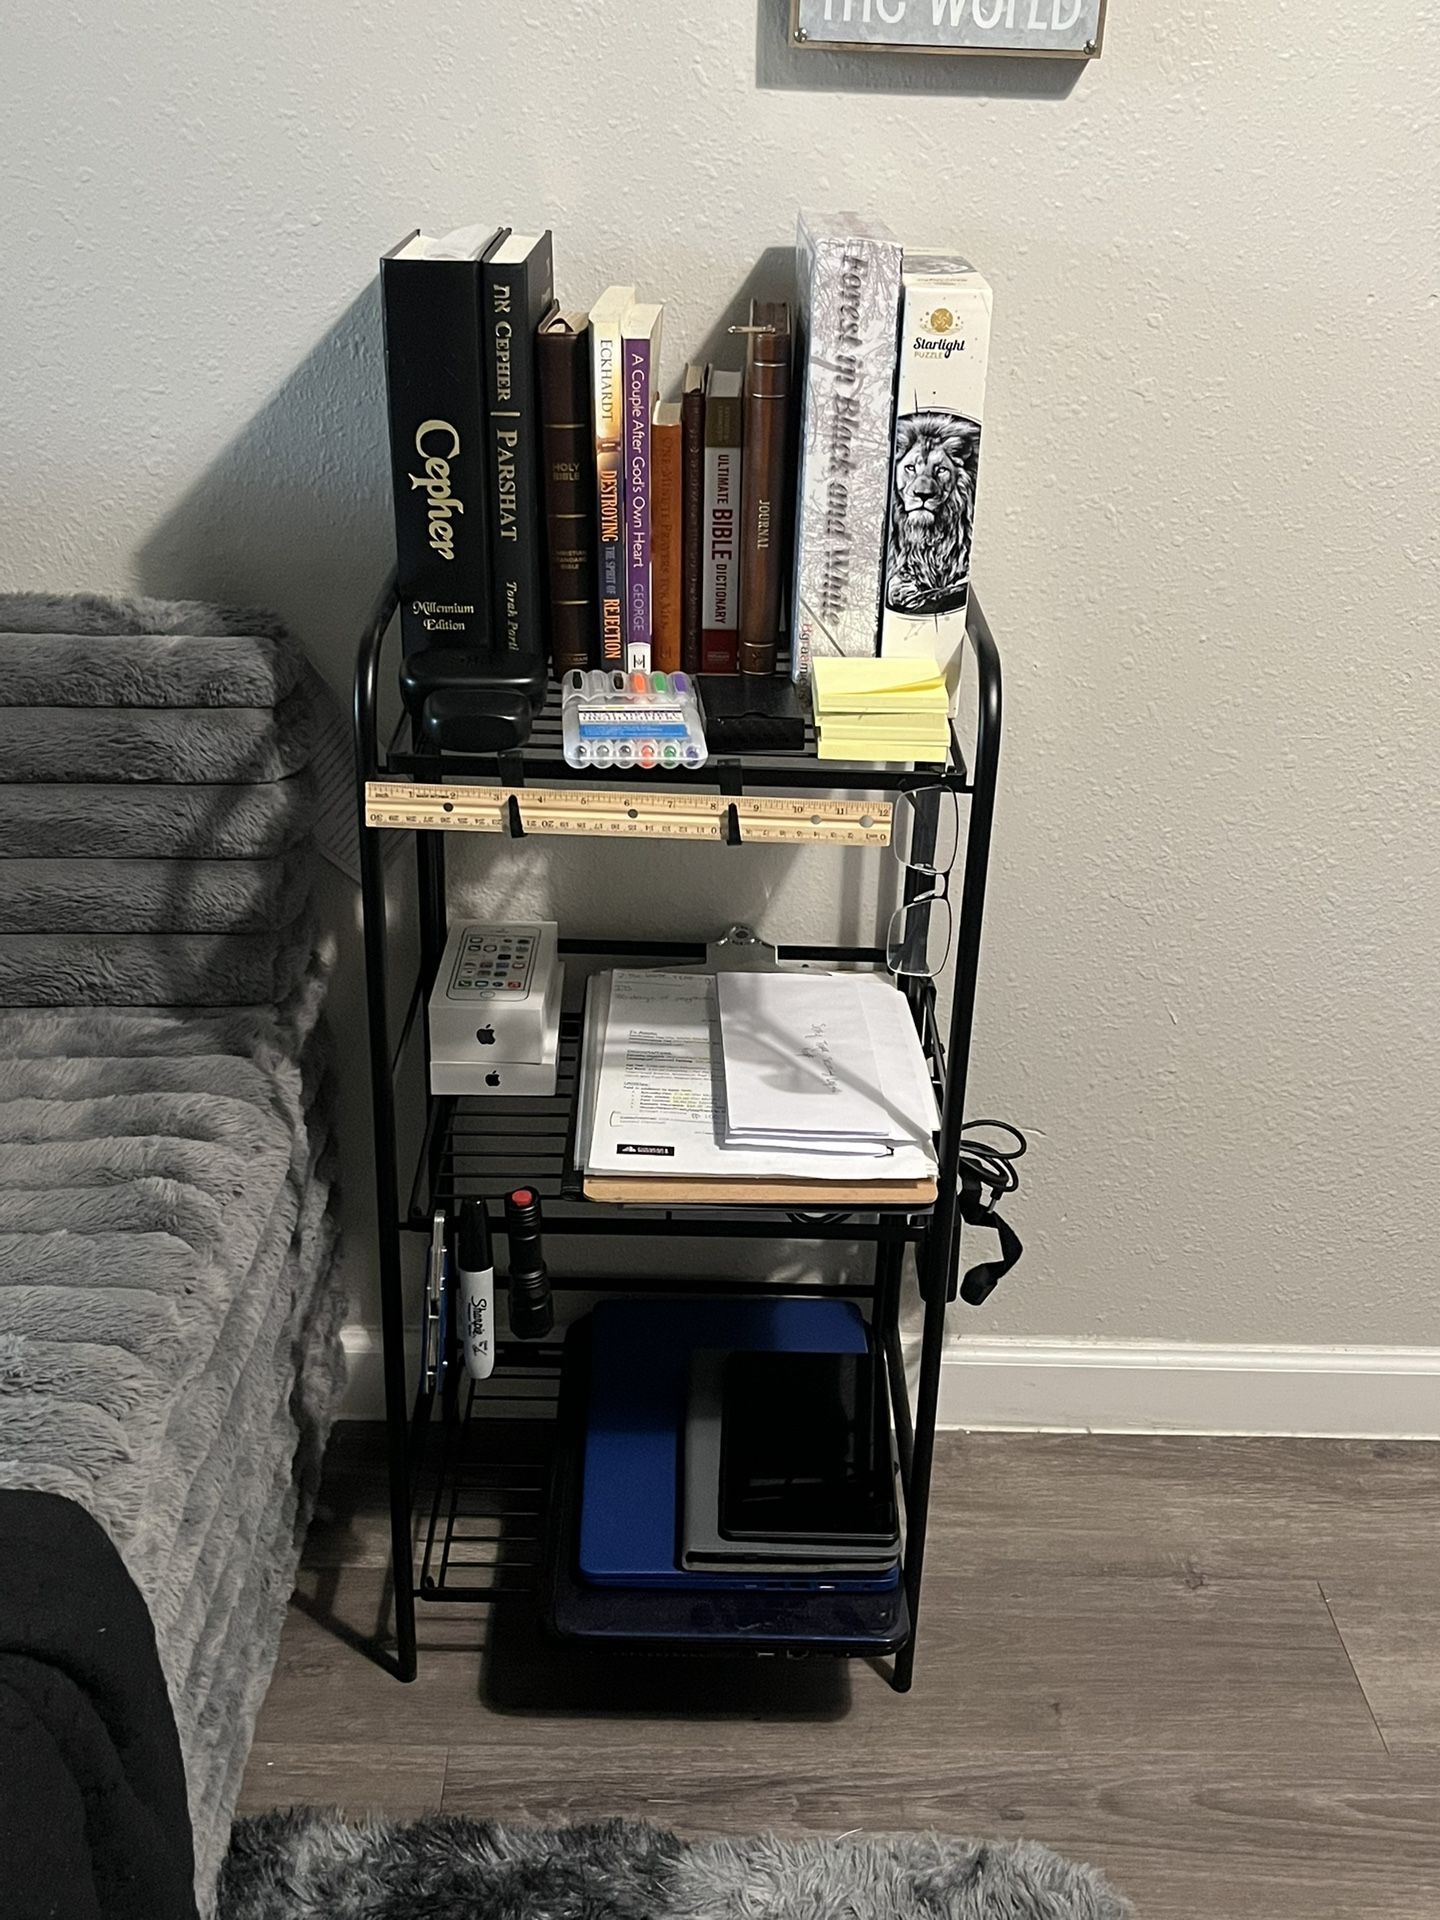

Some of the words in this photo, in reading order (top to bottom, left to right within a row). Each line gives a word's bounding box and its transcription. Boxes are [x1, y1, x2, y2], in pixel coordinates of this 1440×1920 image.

[835, 253, 869, 346] Forest
[494, 320, 512, 402] CEPHER
[632, 353, 645, 366] A
[912, 337, 966, 359] Starlight
[914, 351, 943, 359] PUZZLE
[600, 339, 614, 423] ECKHARDT
[834, 354, 863, 386] in
[627, 369, 646, 417] Couple
[631, 420, 647, 453] After
[827, 394, 861, 479] Black
[497, 429, 519, 542] PARSHAT
[552, 463, 580, 472] HOLY
[632, 456, 646, 493] God's
[716, 453, 730, 505] ULTIMATE
[409, 419, 464, 561] Cepher
[599, 470, 619, 542] DESTROYING
[632, 496, 646, 528] Own
[756, 499, 771, 550] JOURNAL
[825, 481, 855, 537] and
[604, 545, 615, 559] THE
[632, 532, 647, 568] Heart
[712, 508, 733, 560] BIBLE
[604, 560, 616, 584] SPIRIT
[605, 585, 616, 595] OF
[821, 545, 851, 626] White
[412, 600, 475, 616] Millennium
[506, 581, 518, 617] Torah
[631, 582, 645, 632] GEORGE
[714, 563, 727, 625] DICTIONARY
[422, 618, 466, 632] Edition
[507, 620, 520, 651] Porti
[602, 598, 622, 659] REJECTION
[370, 813, 383, 822] 30
[541, 820, 554, 828] 20
[792, 805, 804, 814] 10
[836, 807, 845, 815] 11
[879, 808, 890, 817] 12
[469, 1295, 488, 1339] Sharpie
